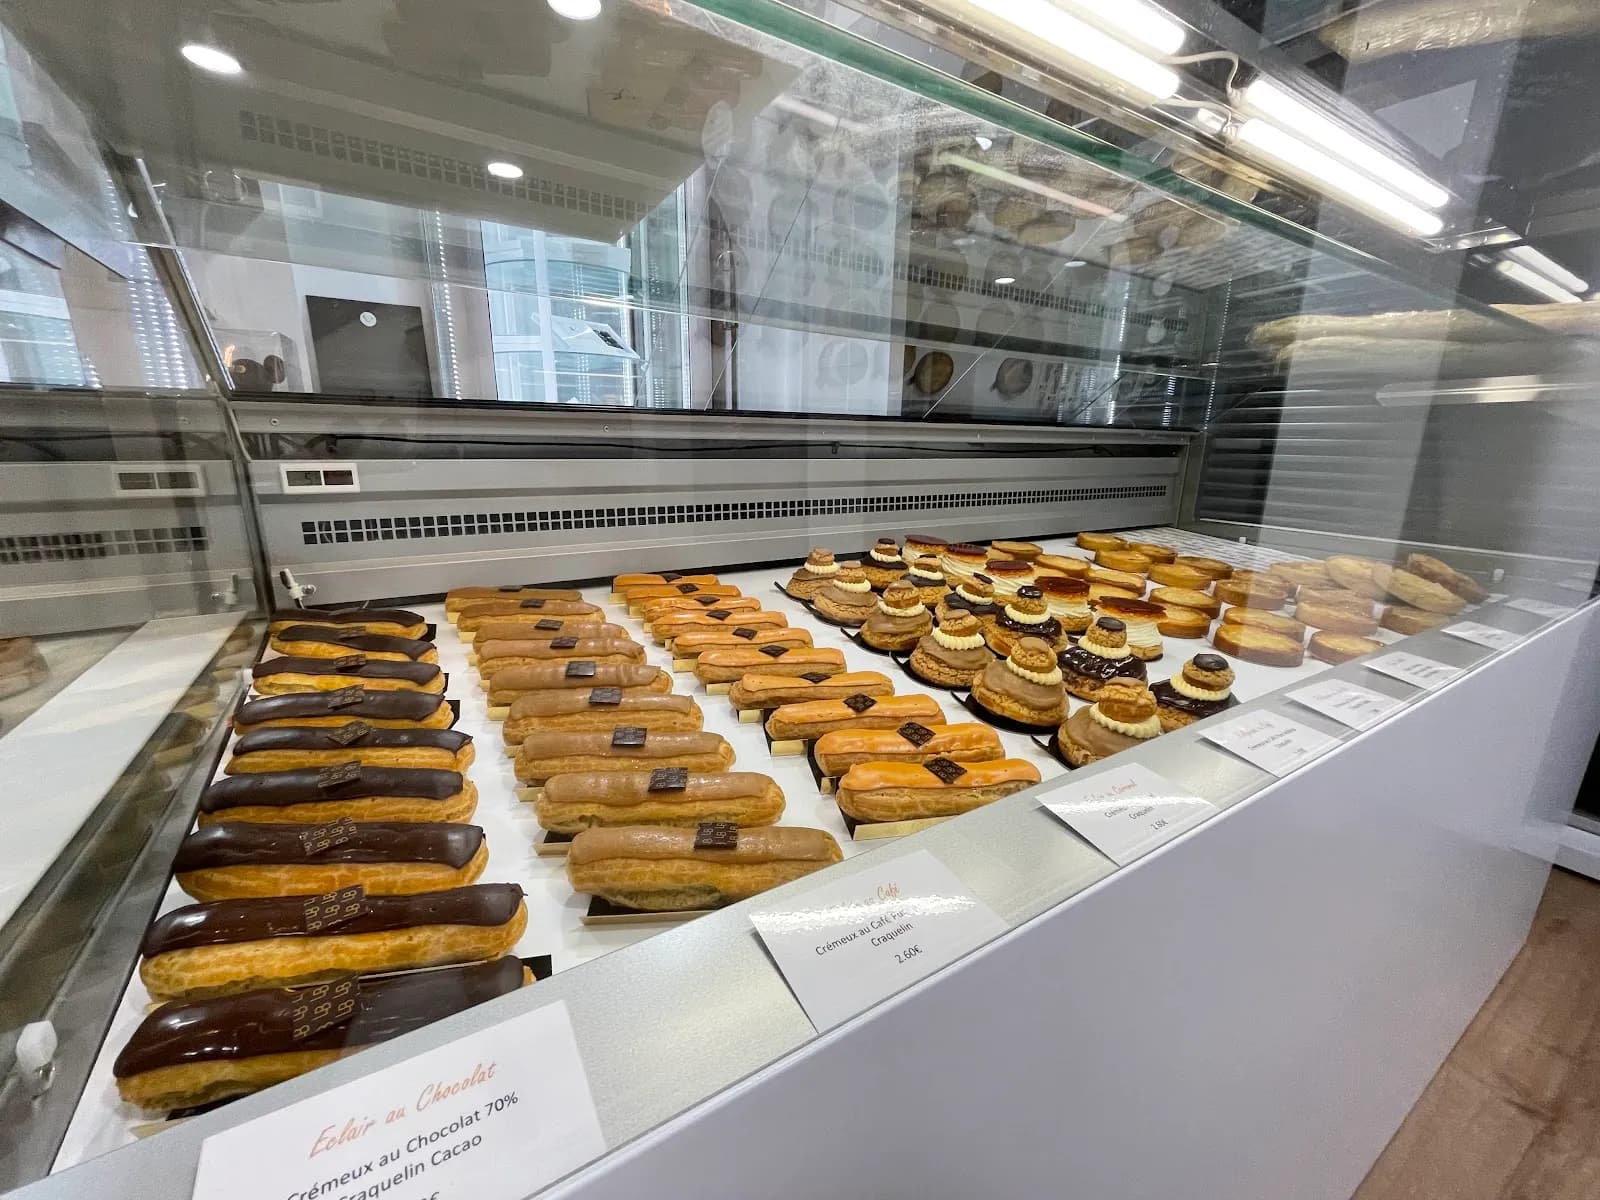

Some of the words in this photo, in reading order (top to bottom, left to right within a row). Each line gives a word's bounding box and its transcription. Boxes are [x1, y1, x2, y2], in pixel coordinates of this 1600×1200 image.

[815, 932, 858, 957] Crémeux
[859, 926, 871, 937] au
[870, 915, 892, 930] Café
[870, 922, 914, 947] Craquelin
[894, 944, 923, 964] 2.60€
[308, 1116, 376, 1160] Eclair
[385, 1106, 406, 1124] au
[416, 1061, 497, 1113] Chocolat
[378, 1148, 400, 1167] au
[406, 1109, 482, 1153] Chocolat
[484, 1091, 519, 1117] 70%
[339, 1161, 425, 1200] aquelin
[430, 1134, 483, 1166] Cacao
